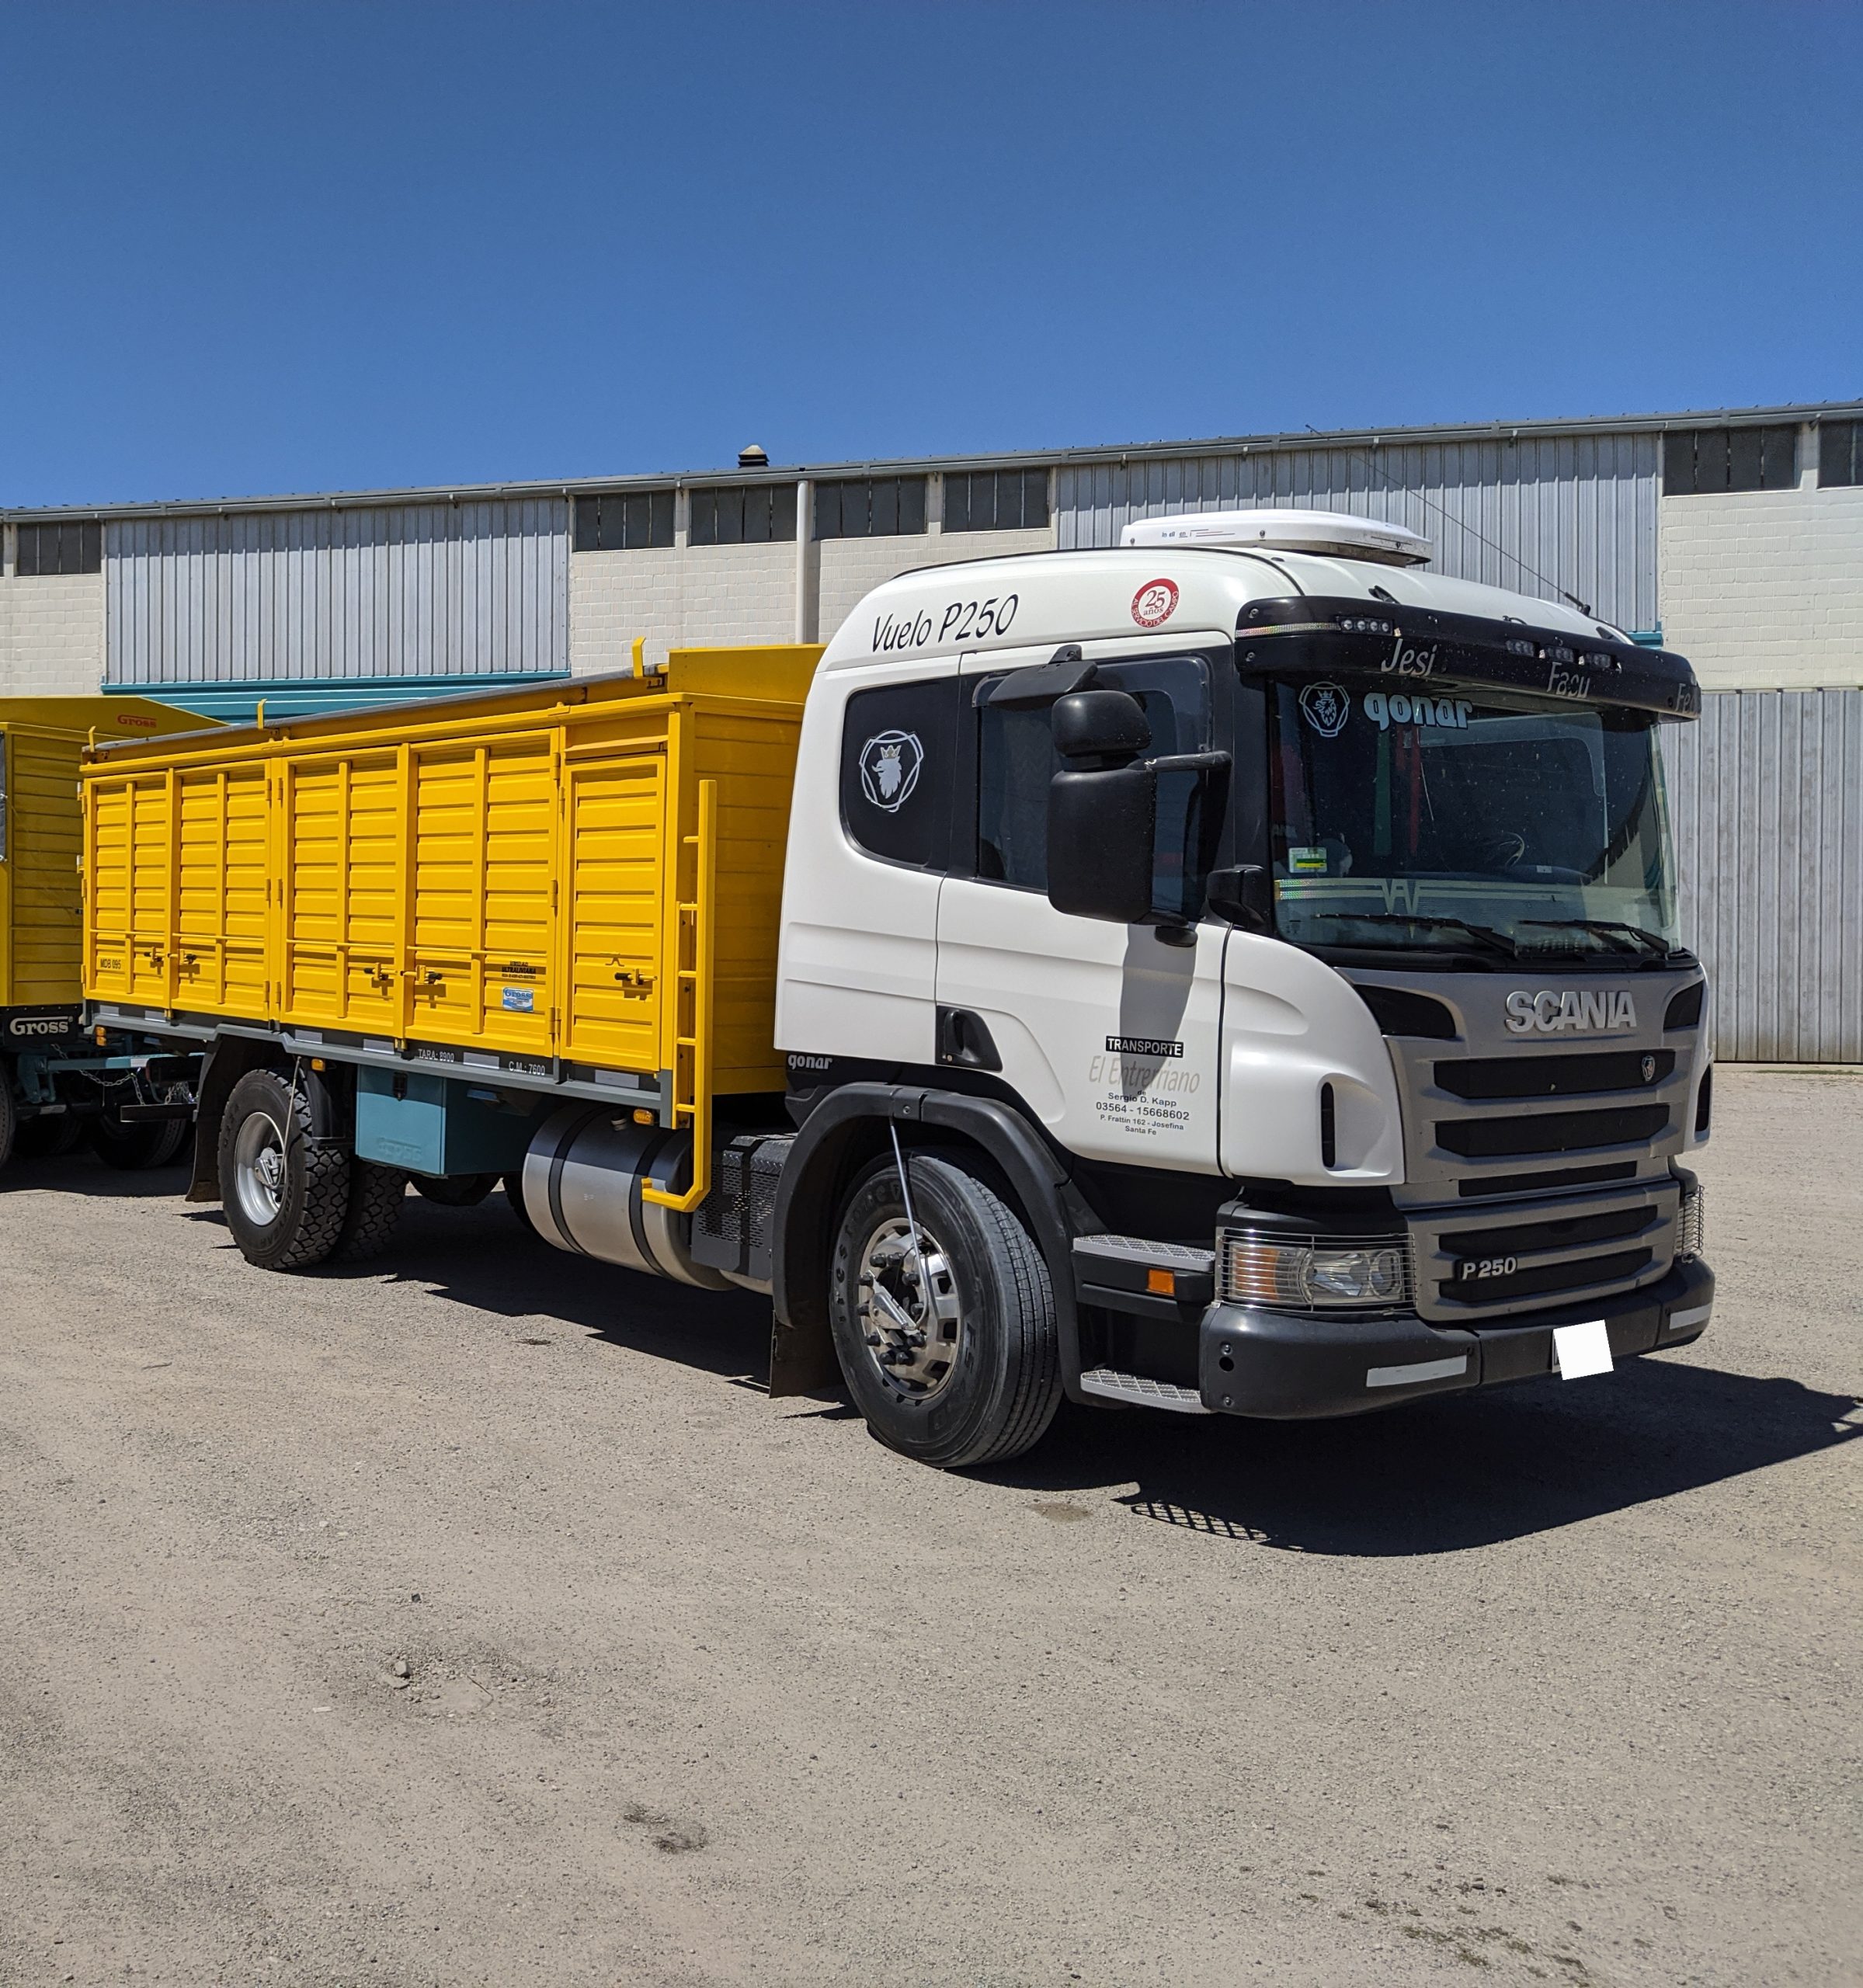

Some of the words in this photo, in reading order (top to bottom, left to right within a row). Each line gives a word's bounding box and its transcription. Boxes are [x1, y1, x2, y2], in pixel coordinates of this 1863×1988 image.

[1145, 589, 1166, 608] 25
[1143, 607, 1163, 616] años
[872, 610, 932, 652] Vuelo
[938, 593, 1019, 643] P250
[1381, 638, 1437, 676] Jesi
[1547, 662, 1590, 699] Facu
[117, 714, 158, 728] Gross
[1505, 990, 1637, 1033] SCANIA
[9, 1016, 73, 1035] Gross
[418, 1049, 438, 1061] TARA:
[440, 1051, 454, 1062] 8900
[1107, 1038, 1182, 1056] TRANSPORTE
[529, 1064, 545, 1076] 7600
[1089, 1055, 1106, 1083] El
[1108, 1057, 1200, 1093] Entrerriano
[1108, 1092, 1138, 1102] Sergio
[1152, 1097, 1177, 1107] Kapp
[1096, 1101, 1127, 1113] 03564
[1137, 1107, 1190, 1121] 15668602
[1107, 1114, 1131, 1124] Frattin
[1152, 1121, 1184, 1130] Josefina
[1125, 1125, 1146, 1135] Santa
[1477, 1256, 1517, 1278] 250
